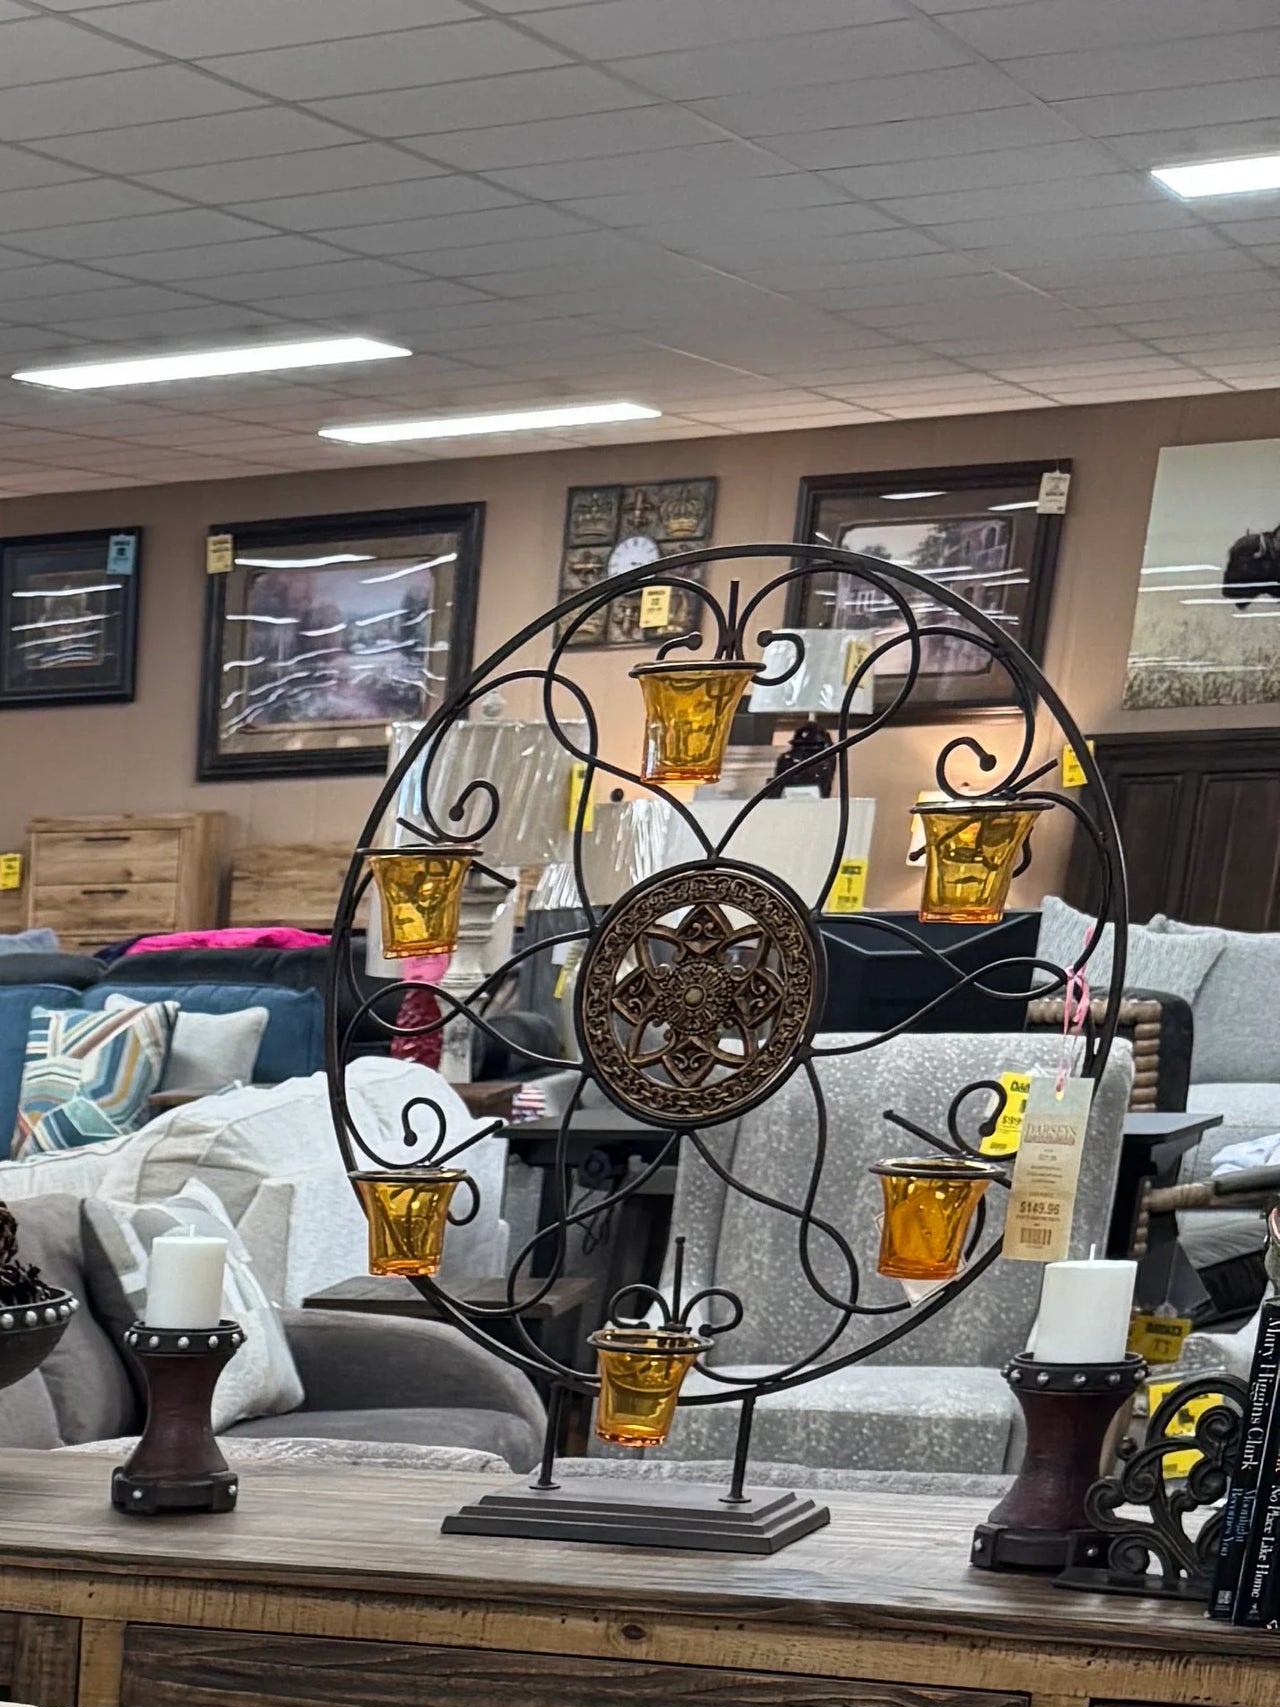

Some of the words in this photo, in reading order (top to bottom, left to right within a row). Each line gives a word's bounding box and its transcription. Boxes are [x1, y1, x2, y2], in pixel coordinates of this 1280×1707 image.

[1258, 1317, 1280, 1359] Mary
[1249, 1364, 1277, 1424] Higgins
[1241, 1427, 1264, 1470] Clark
[1263, 1505, 1280, 1534] Place
[1258, 1537, 1275, 1559] Like
[1251, 1564, 1270, 1598] Home
